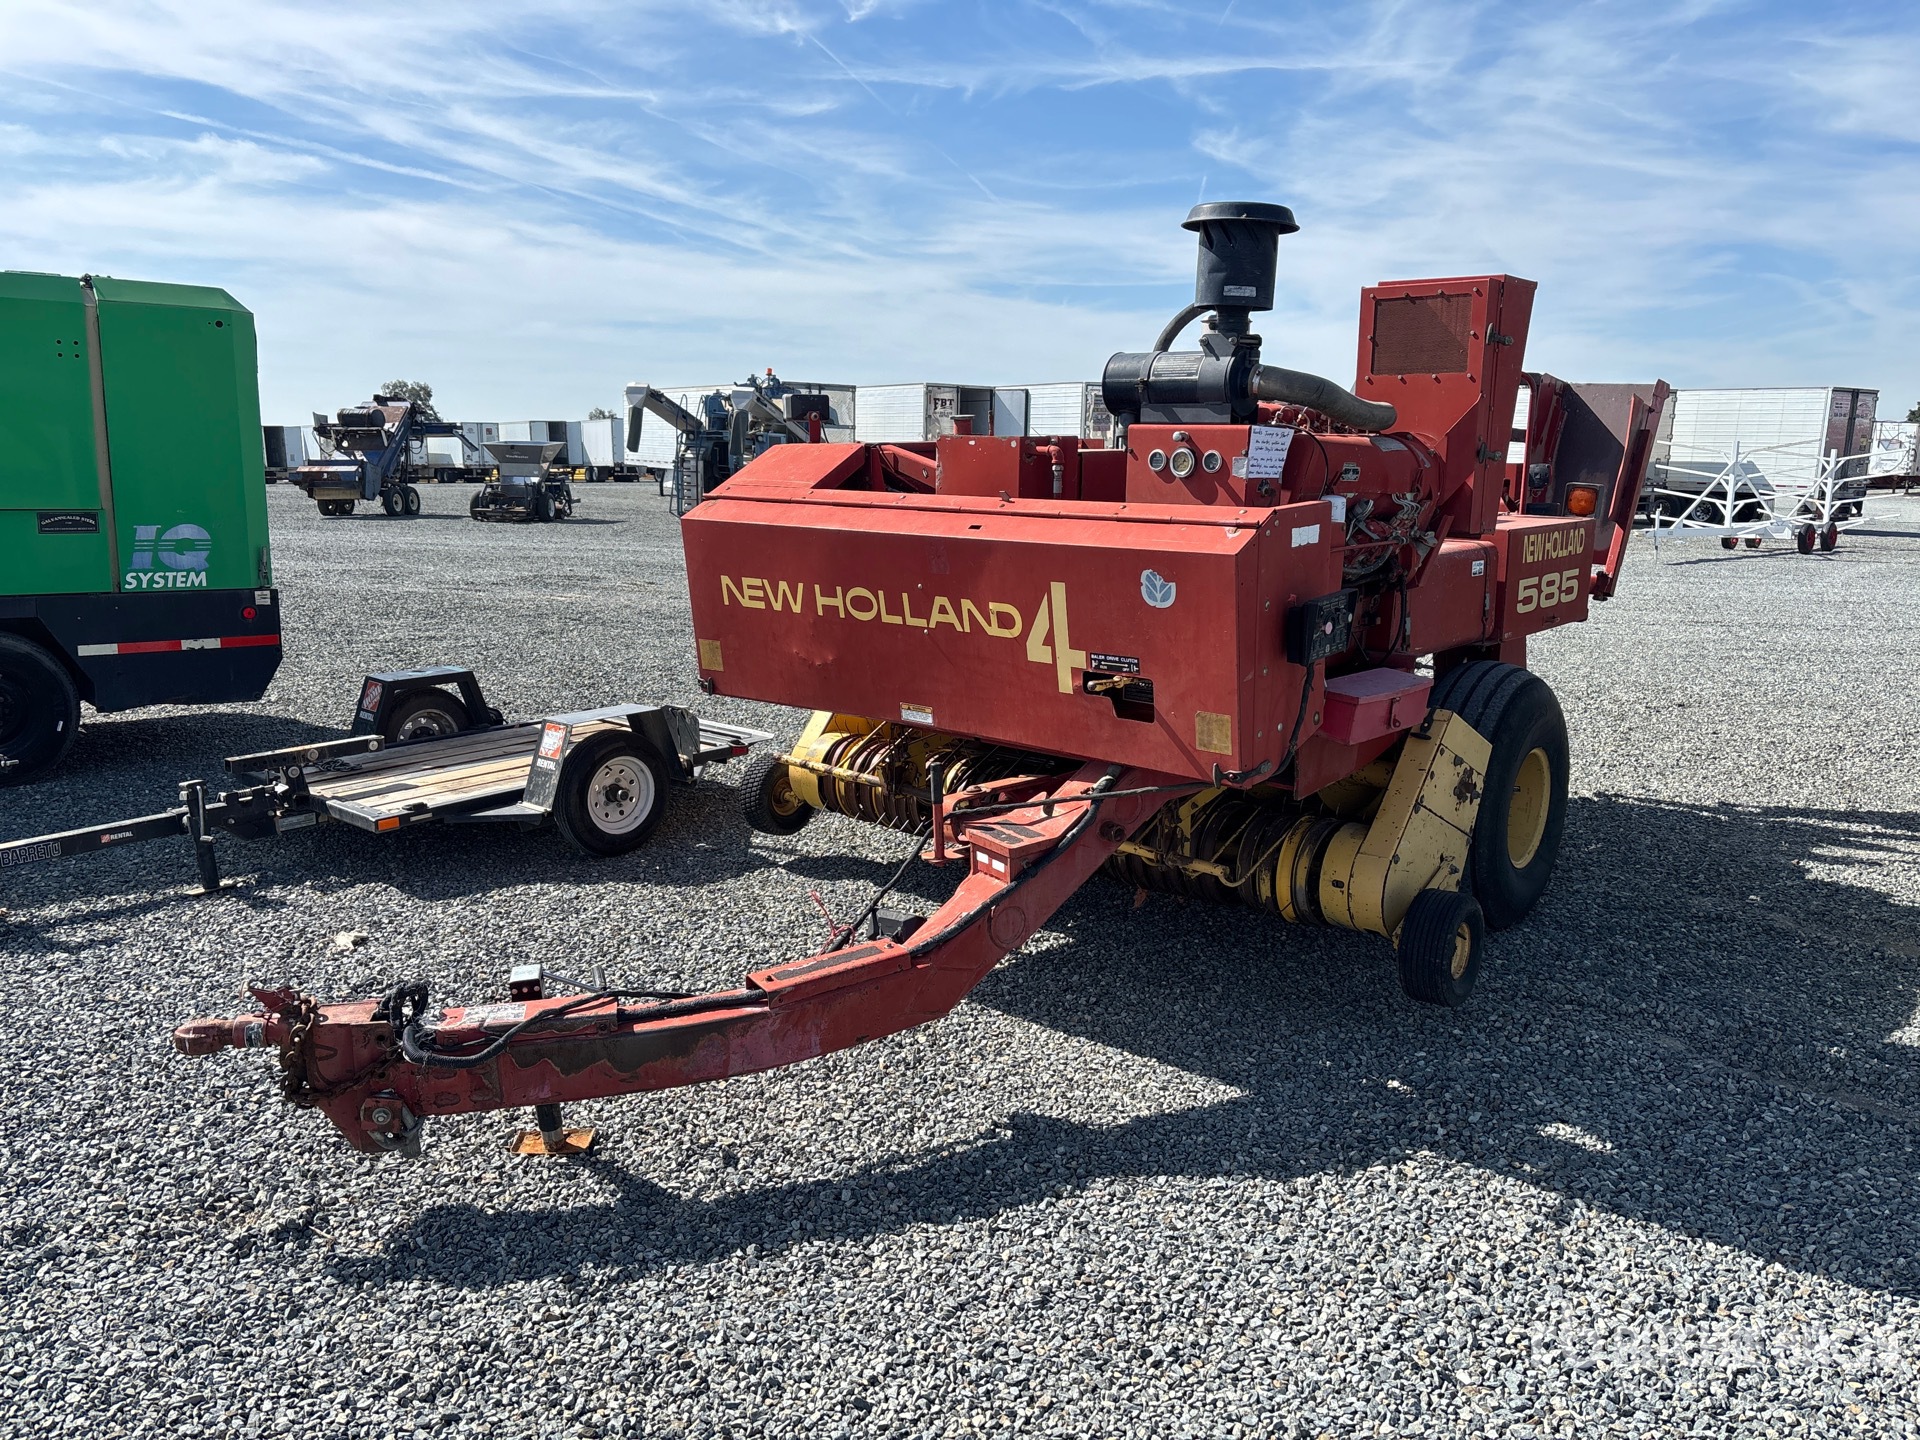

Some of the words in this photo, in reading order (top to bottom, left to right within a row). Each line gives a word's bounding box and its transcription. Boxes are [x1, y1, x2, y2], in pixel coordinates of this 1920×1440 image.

[933, 397, 954, 411] FBT
[128, 524, 212, 571] IQ
[1522, 532, 1545, 564] NEW
[1545, 528, 1585, 560] HOLLAND
[125, 571, 207, 589] SYSTEM
[1516, 568, 1580, 614] 585
[720, 574, 804, 614] NEW
[814, 583, 1023, 639] HOLLAND
[1025, 581, 1087, 695] 4
[536, 757, 556, 771] RENTAL
[110, 831, 134, 841] RENTAL
[0, 841, 62, 867] BARRETO
